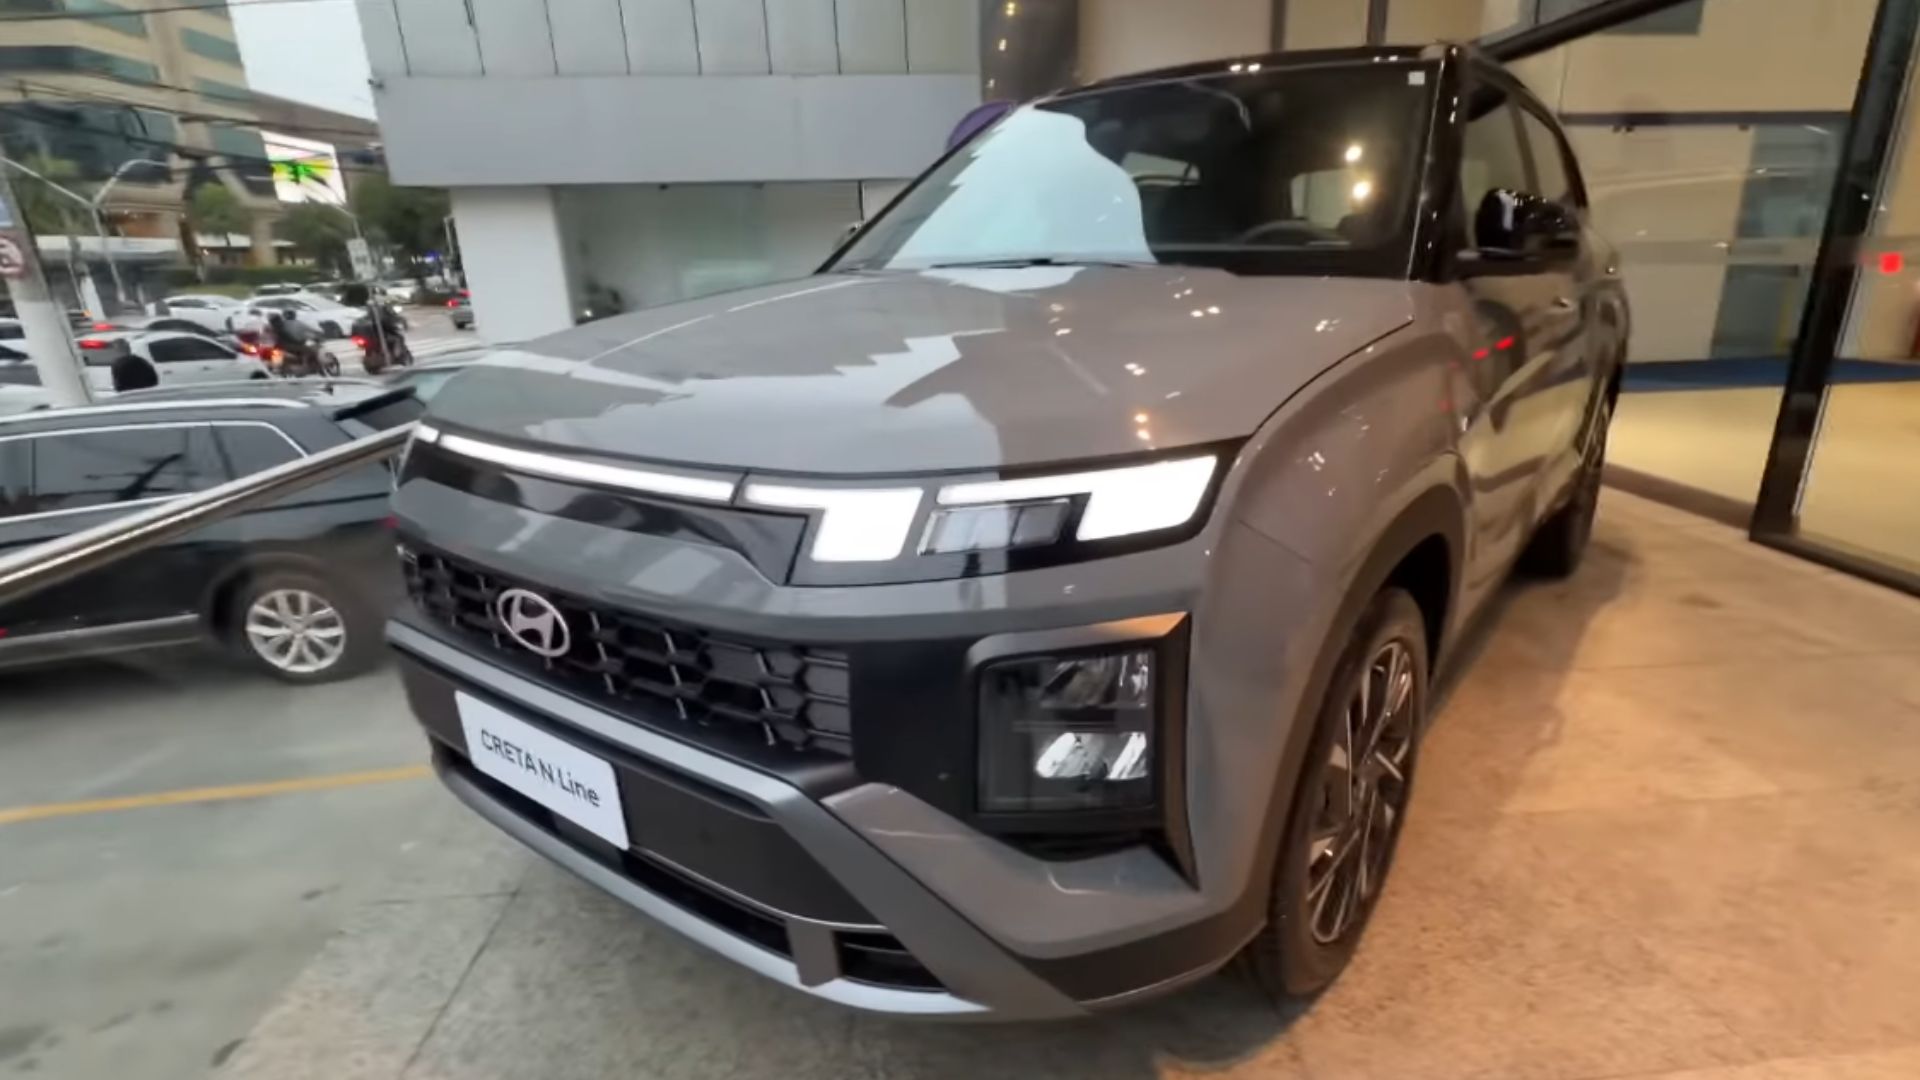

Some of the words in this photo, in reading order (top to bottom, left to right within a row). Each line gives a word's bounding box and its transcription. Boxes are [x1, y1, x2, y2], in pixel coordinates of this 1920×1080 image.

[481, 729, 536, 776] CRETA
[538, 758, 554, 784] N
[558, 769, 600, 808] Line
